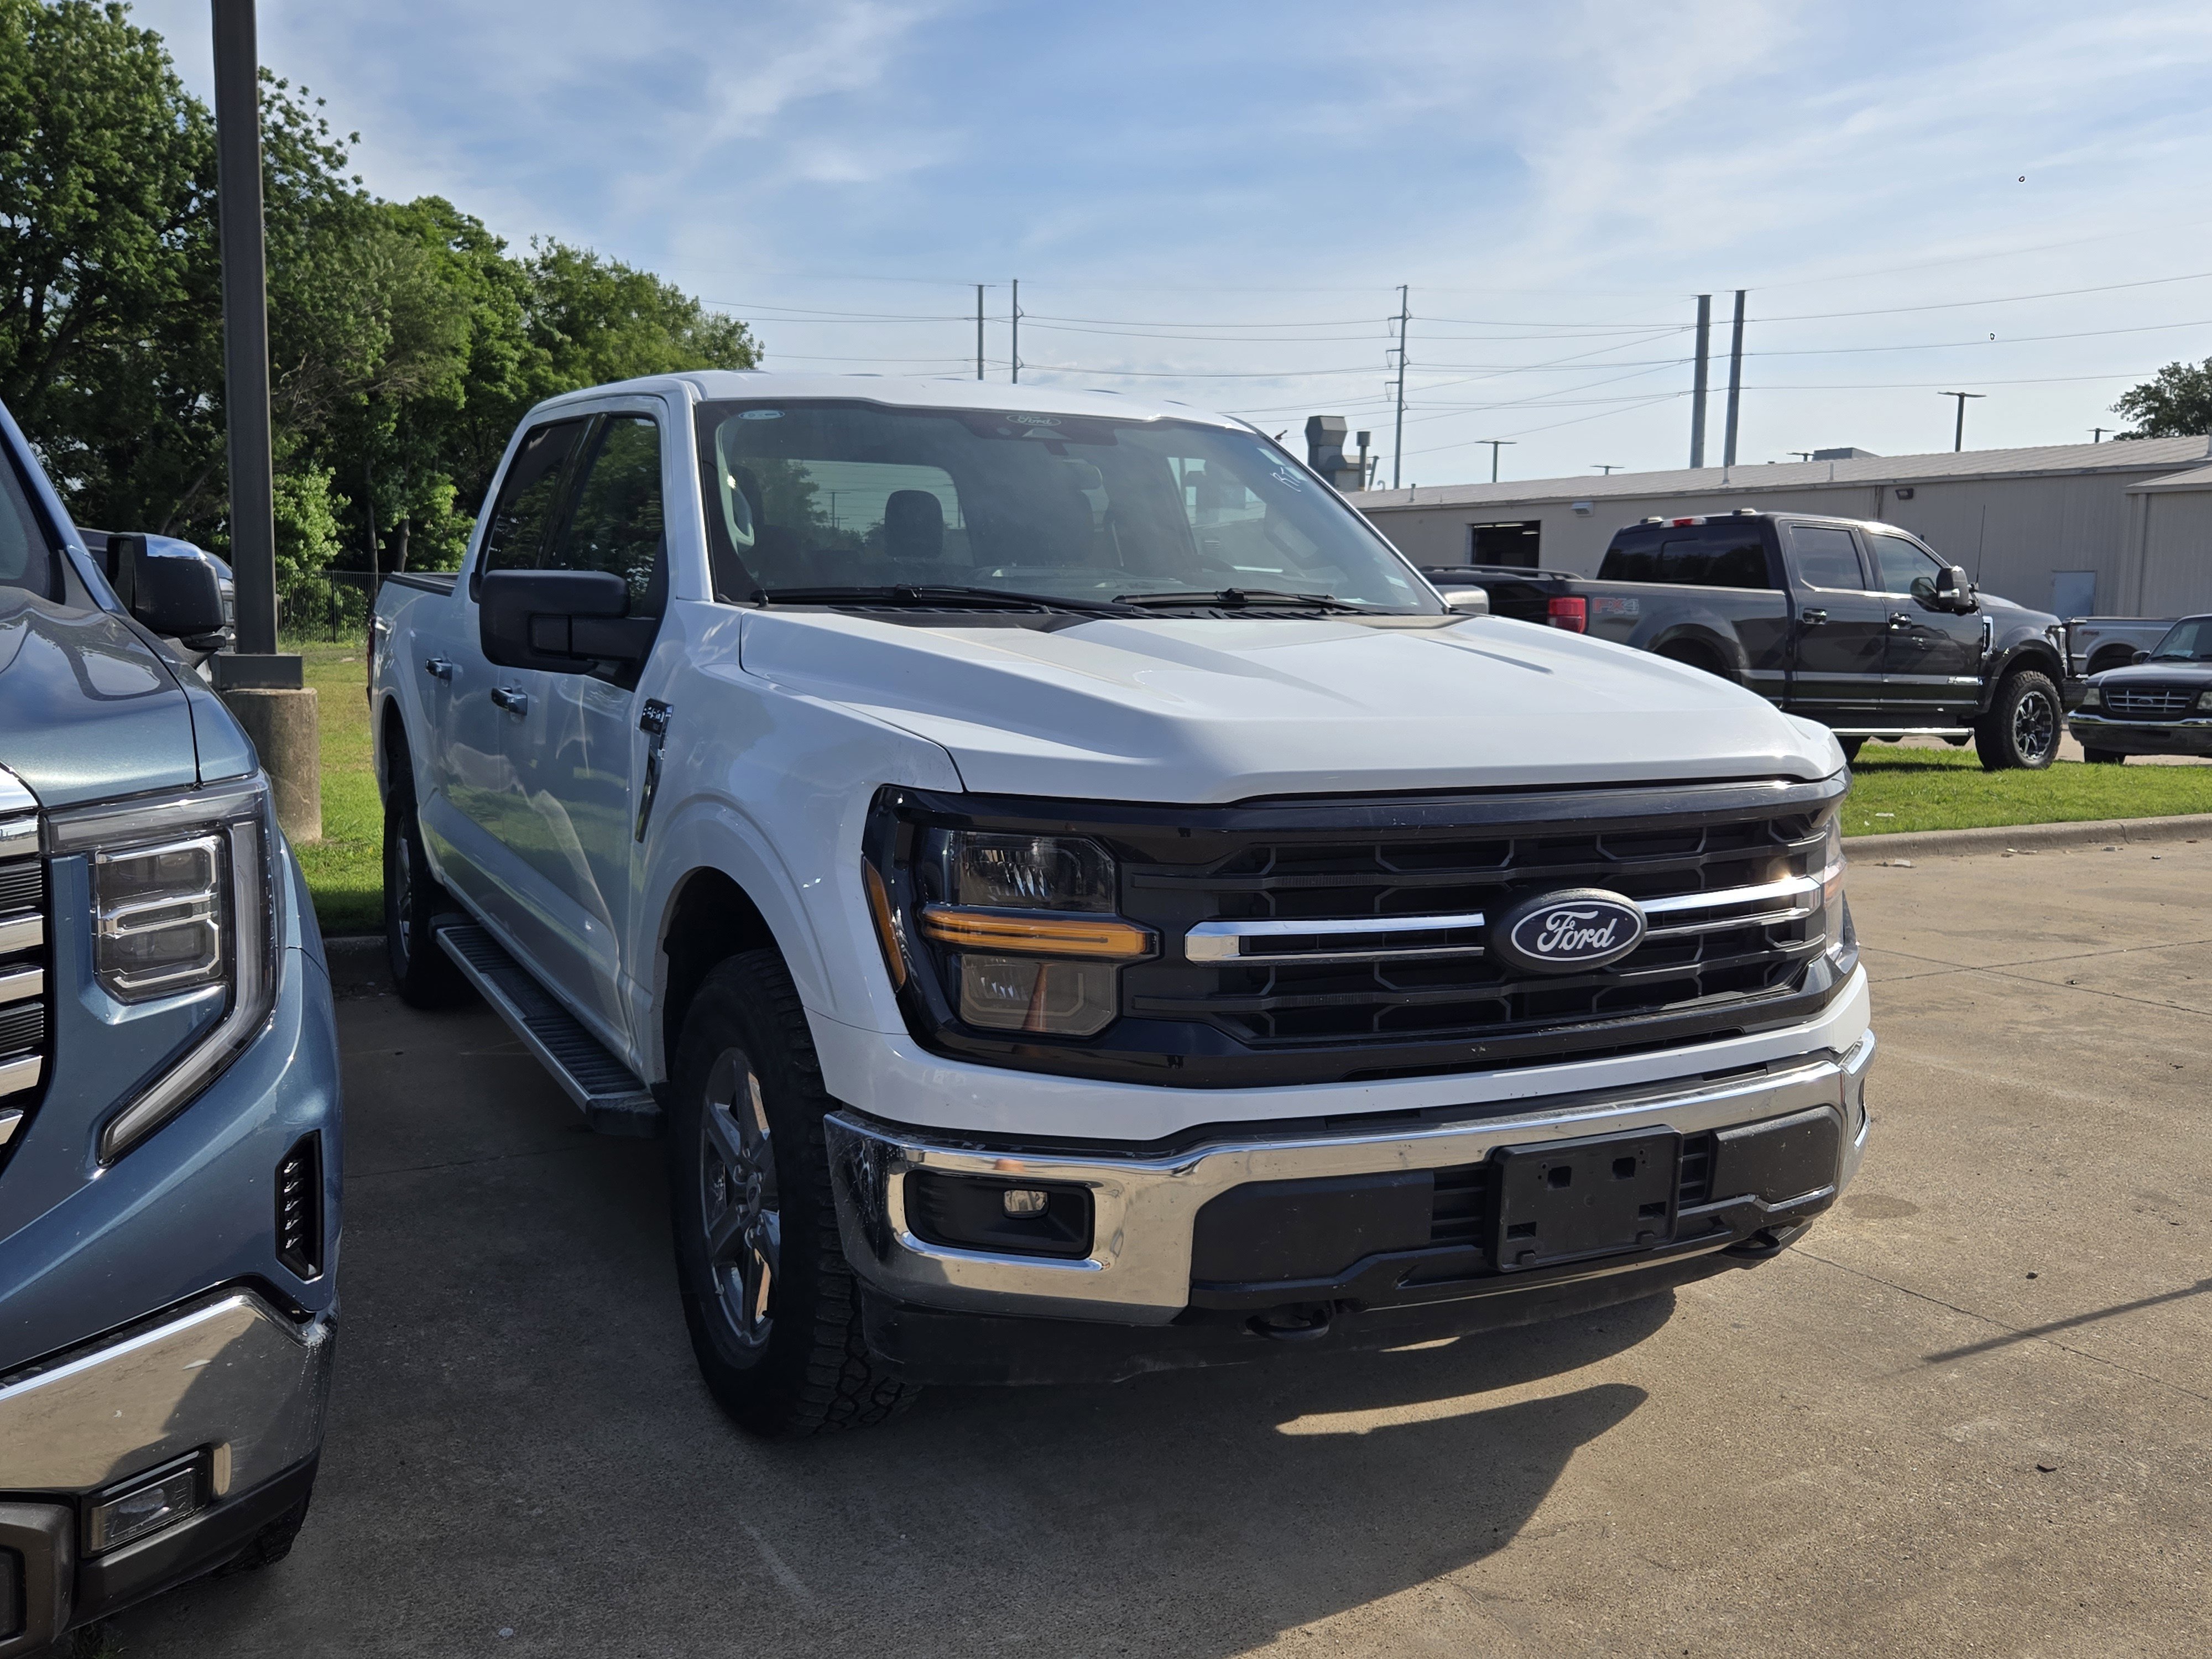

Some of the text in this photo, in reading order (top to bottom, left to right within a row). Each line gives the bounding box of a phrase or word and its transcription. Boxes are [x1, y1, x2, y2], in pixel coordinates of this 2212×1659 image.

[1018, 415, 1052, 425] Ford
[1592, 597, 1639, 615] FX4
[1537, 911, 1618, 952] Ford
